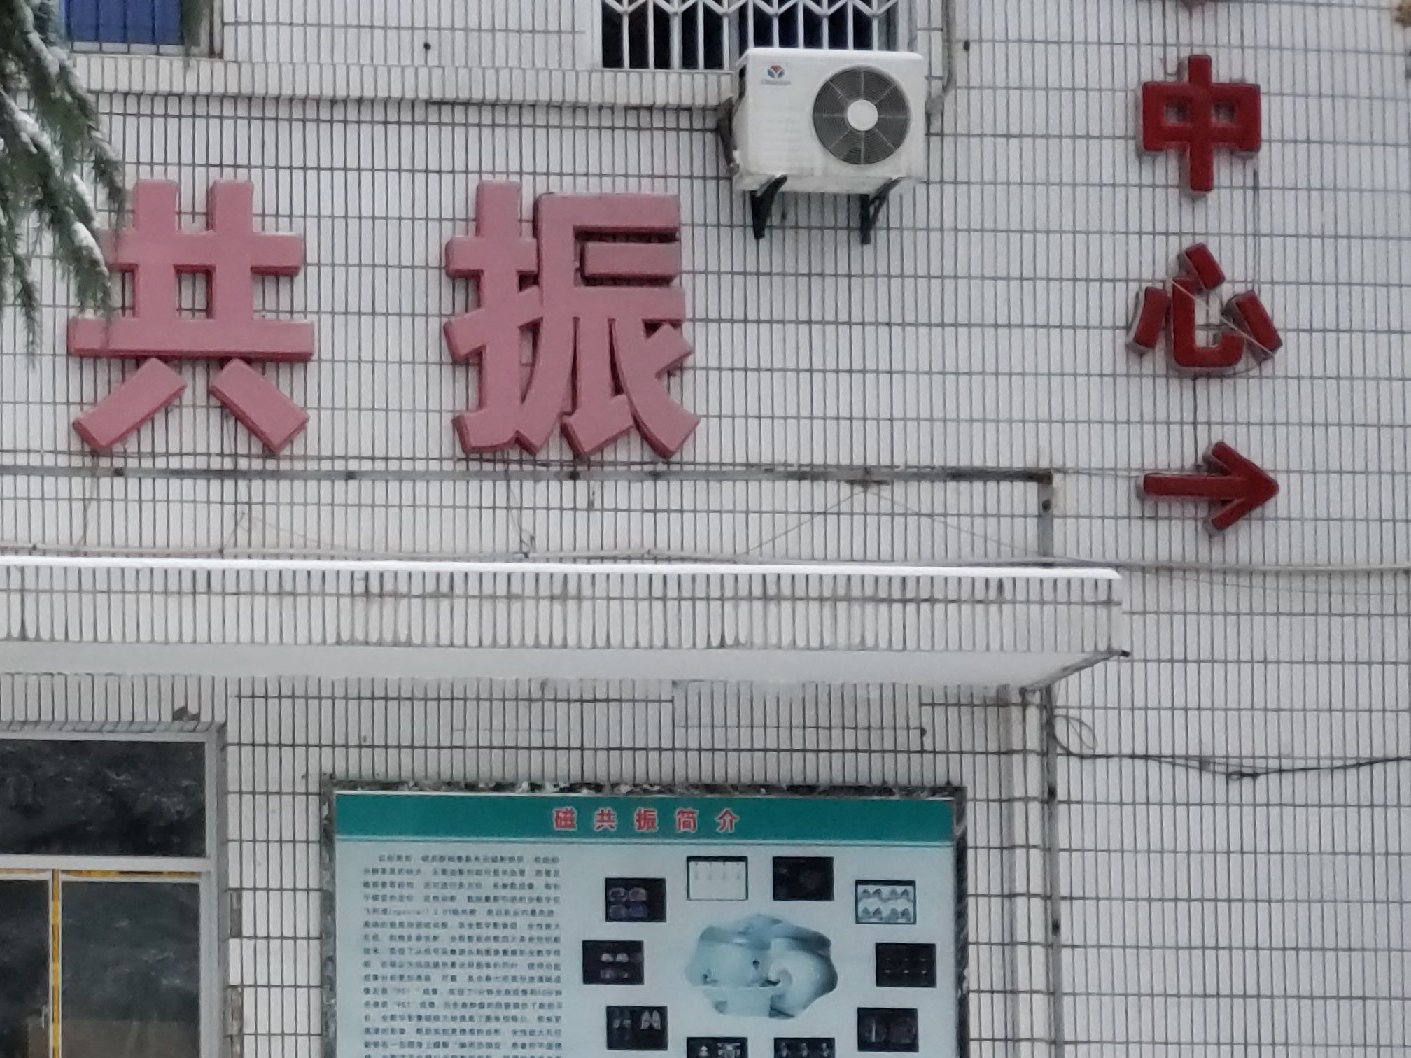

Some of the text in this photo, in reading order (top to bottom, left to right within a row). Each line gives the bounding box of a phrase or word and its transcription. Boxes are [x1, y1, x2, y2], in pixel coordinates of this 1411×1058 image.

[553, 807, 739, 832] 磁共振简介
